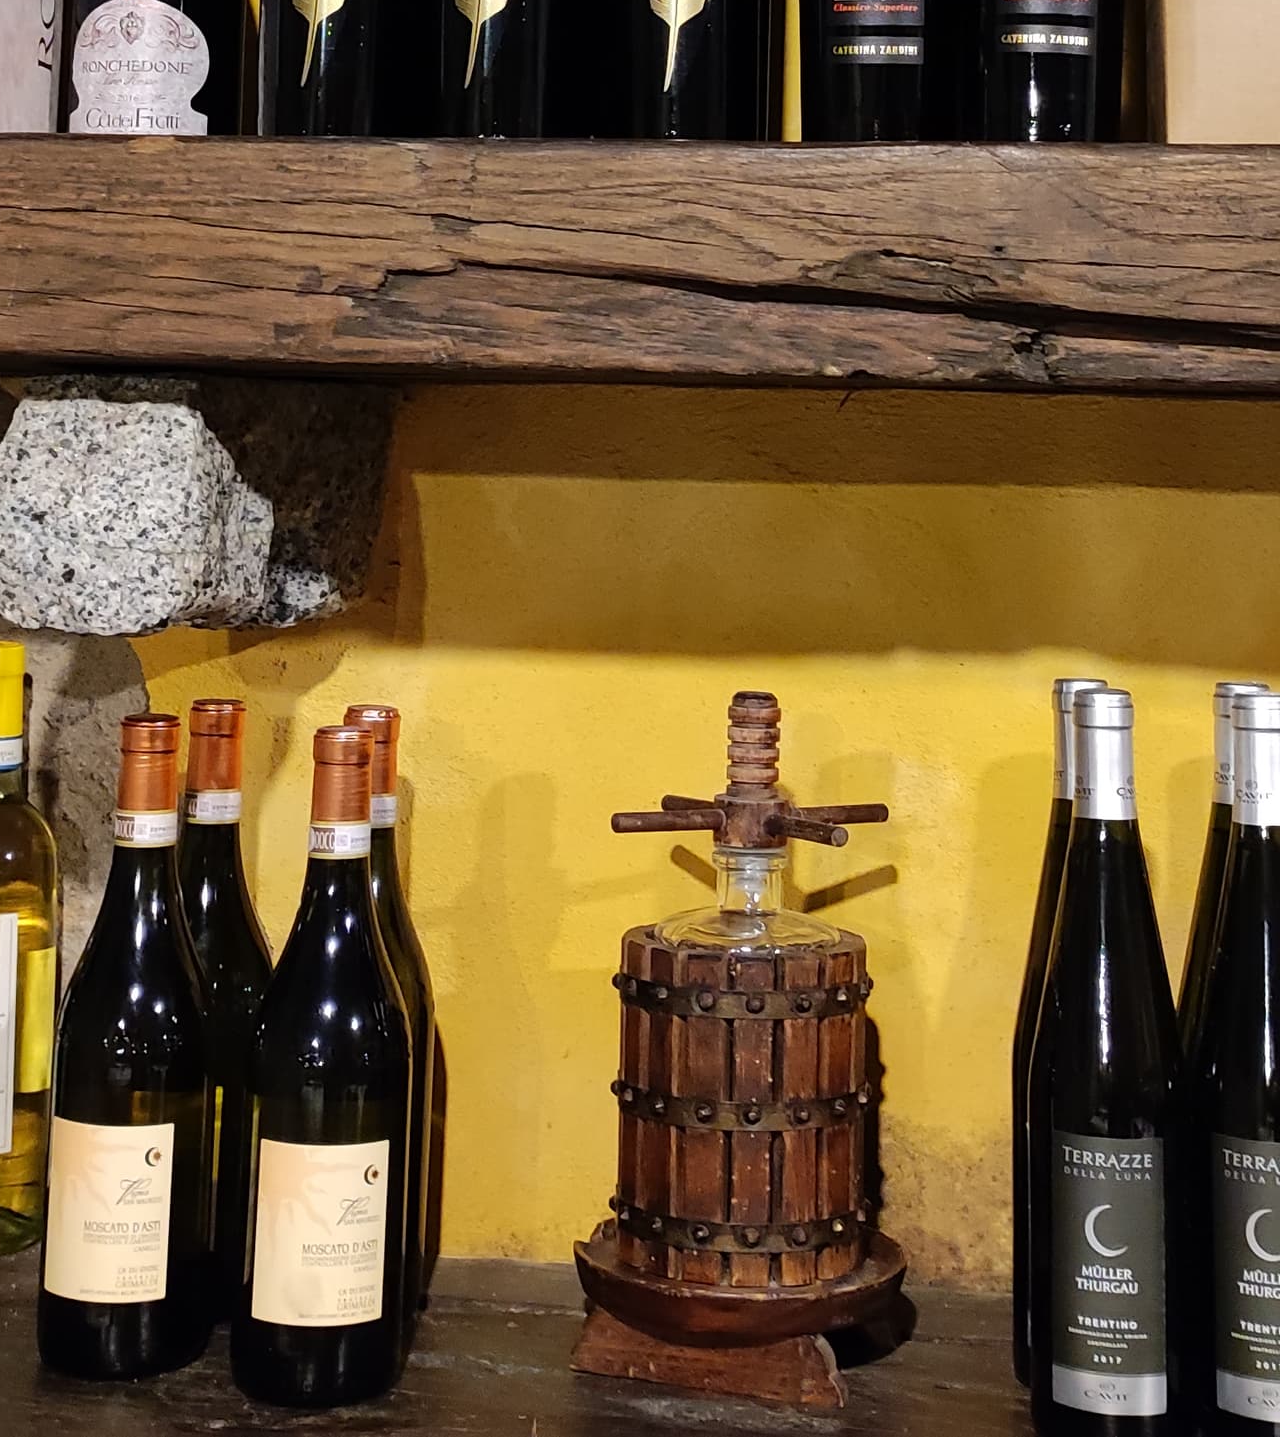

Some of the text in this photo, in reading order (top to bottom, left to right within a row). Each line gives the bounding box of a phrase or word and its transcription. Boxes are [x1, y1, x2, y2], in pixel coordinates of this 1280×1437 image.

[833, 2, 918, 13] Classico Superiore
[1001, 33, 1089, 47] CATERINA ZARDINI
[832, 44, 919, 56] CATERINA ZARDINI
[81, 60, 193, 75] RONCHEDONE
[1062, 1144, 1153, 1170] TERRAZZE
[1064, 1166, 1152, 1181] DELLA LUNA
[1224, 1169, 1266, 1184] DELLA
[83, 1220, 129, 1234] MOSCATO
[302, 1243, 348, 1256] MOSCATO
[1081, 1264, 1133, 1281] MÜLLER
[1075, 1276, 1139, 1295] THURGAU
[1077, 1315, 1138, 1331] TRENTINO
